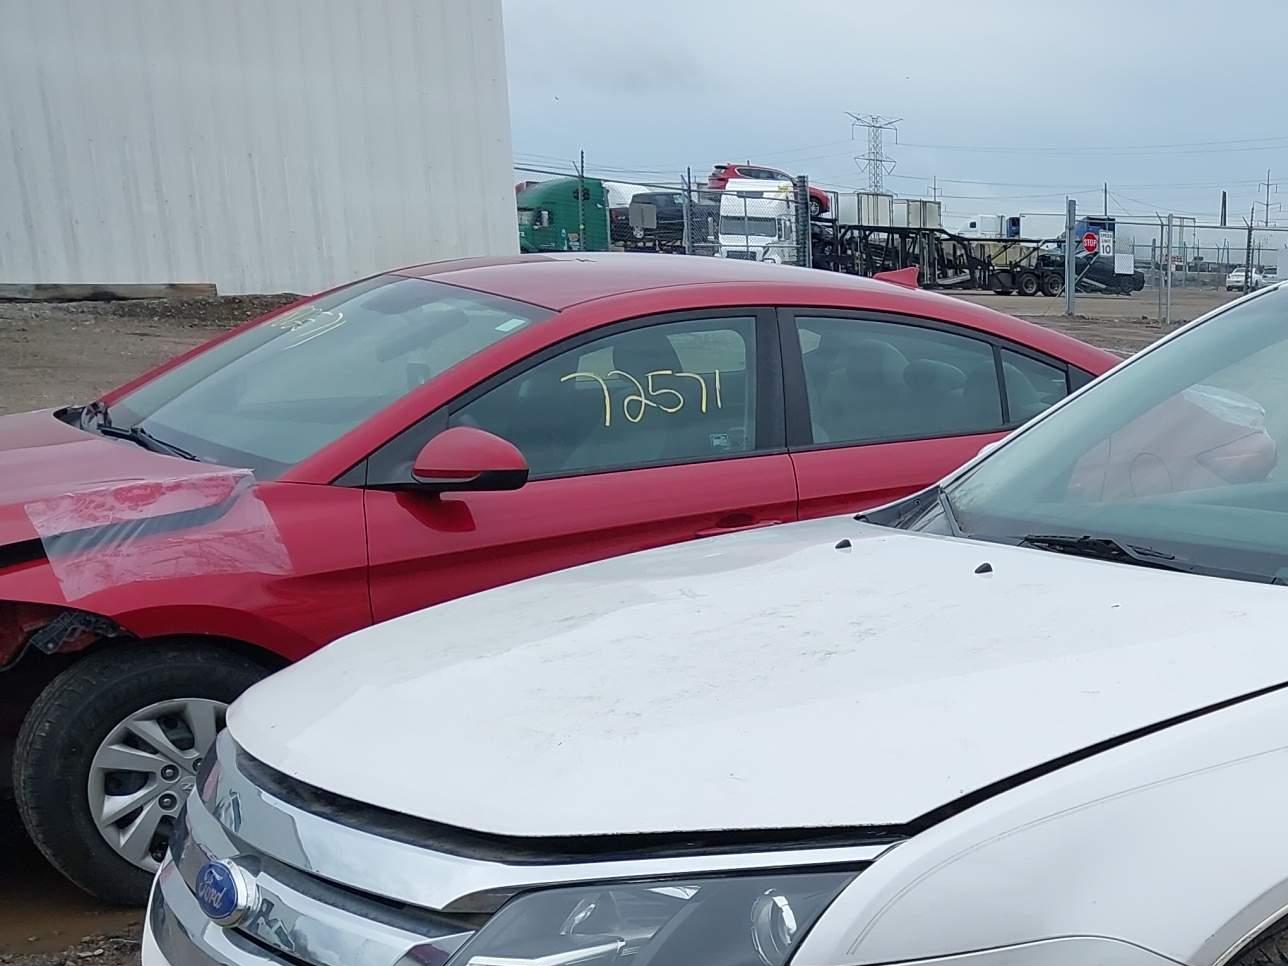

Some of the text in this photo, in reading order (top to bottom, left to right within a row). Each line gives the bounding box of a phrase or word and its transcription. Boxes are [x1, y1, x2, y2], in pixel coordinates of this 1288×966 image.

[1101, 244, 1111, 254] 10
[560, 369, 722, 427] 72571
[199, 868, 227, 909] Ford
